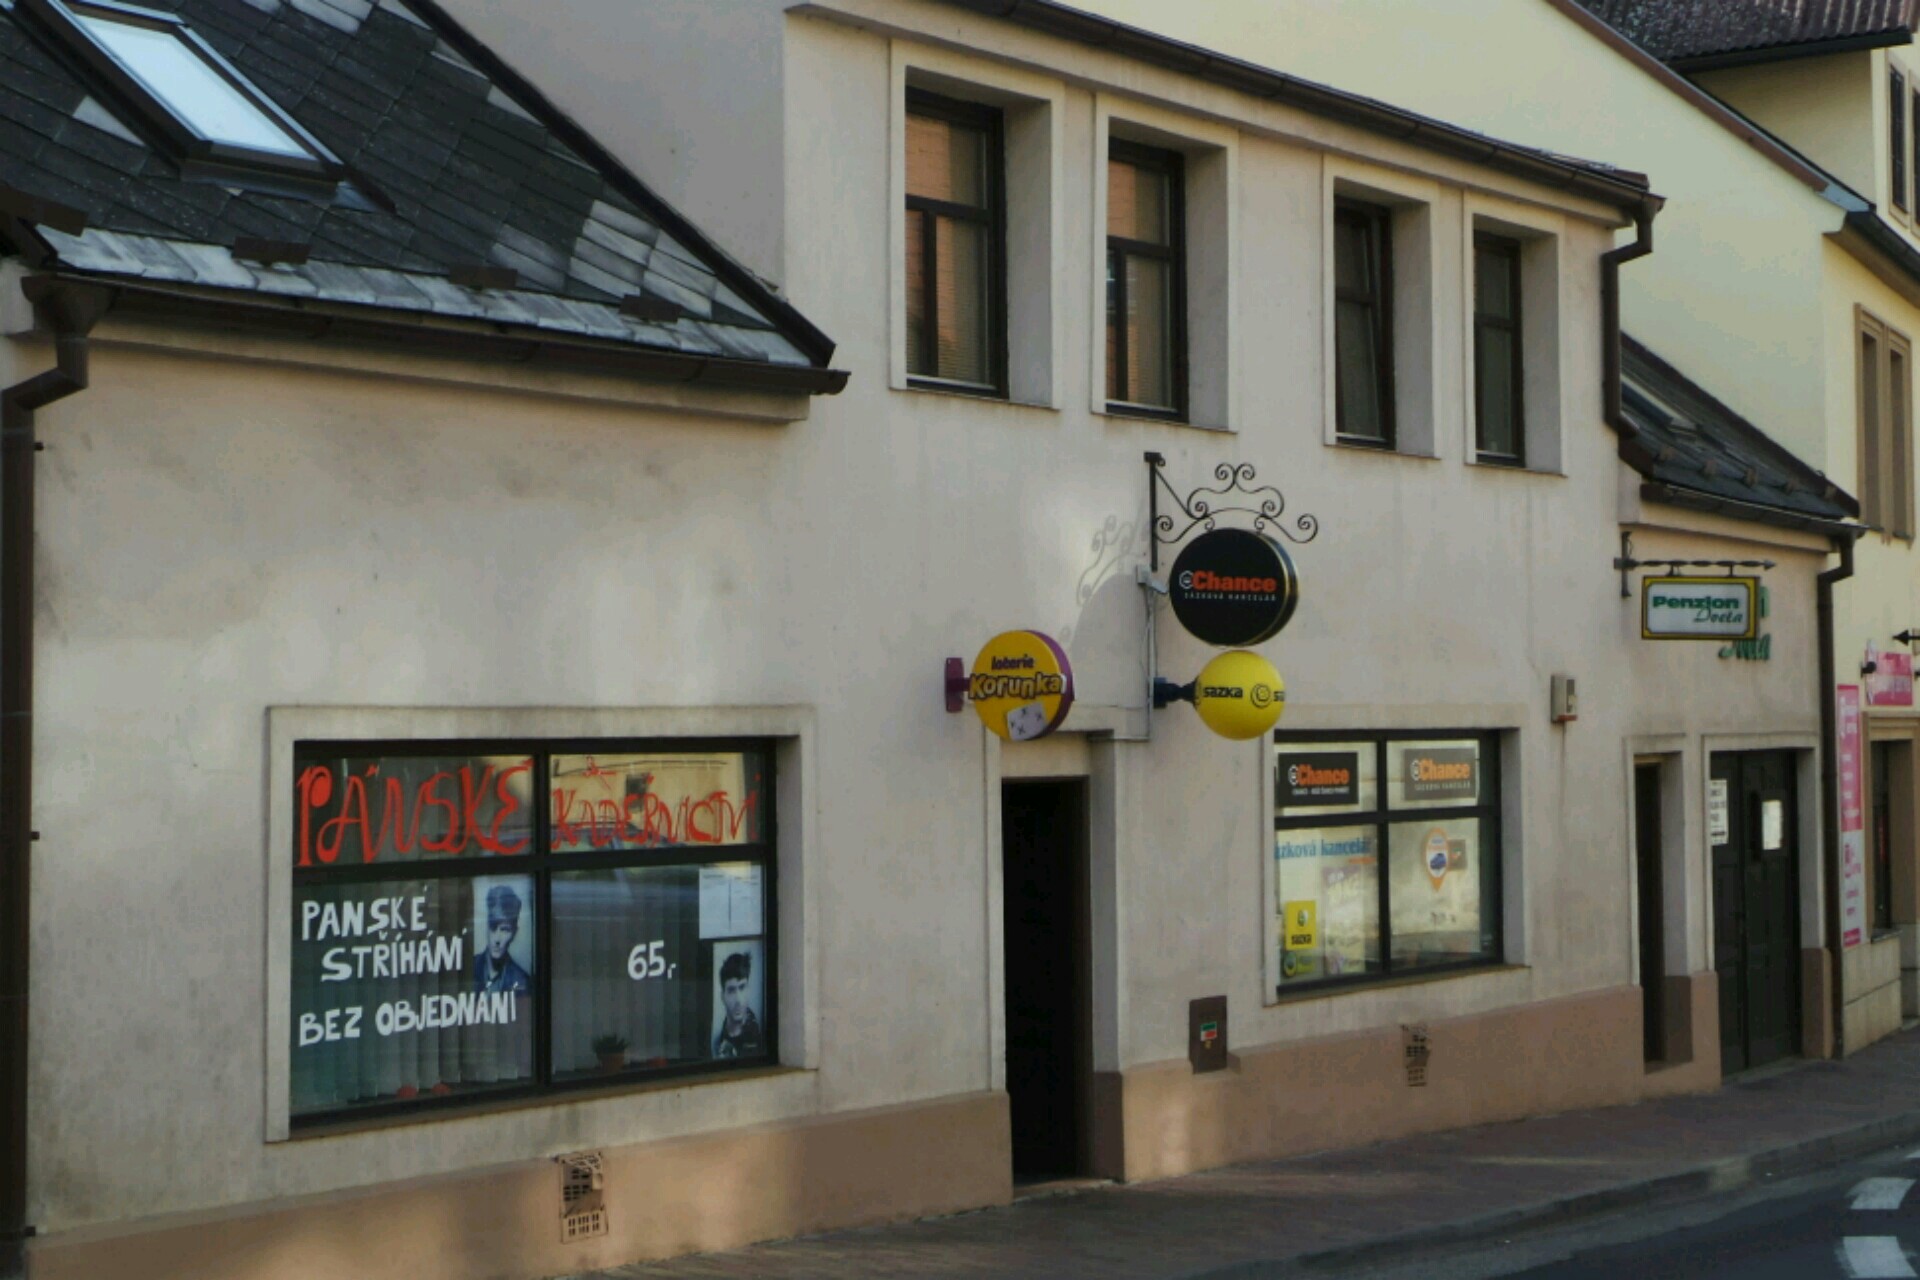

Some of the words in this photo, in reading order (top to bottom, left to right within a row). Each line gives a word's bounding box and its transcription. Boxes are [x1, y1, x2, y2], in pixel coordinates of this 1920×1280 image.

[1192, 570, 1277, 592] Chance
[1652, 595, 1739, 609] Penzion
[968, 672, 1064, 700] Korunka
[1296, 763, 1349, 787] Chance
[1419, 758, 1471, 781] Chance
[299, 1006, 363, 1047] BEZ
